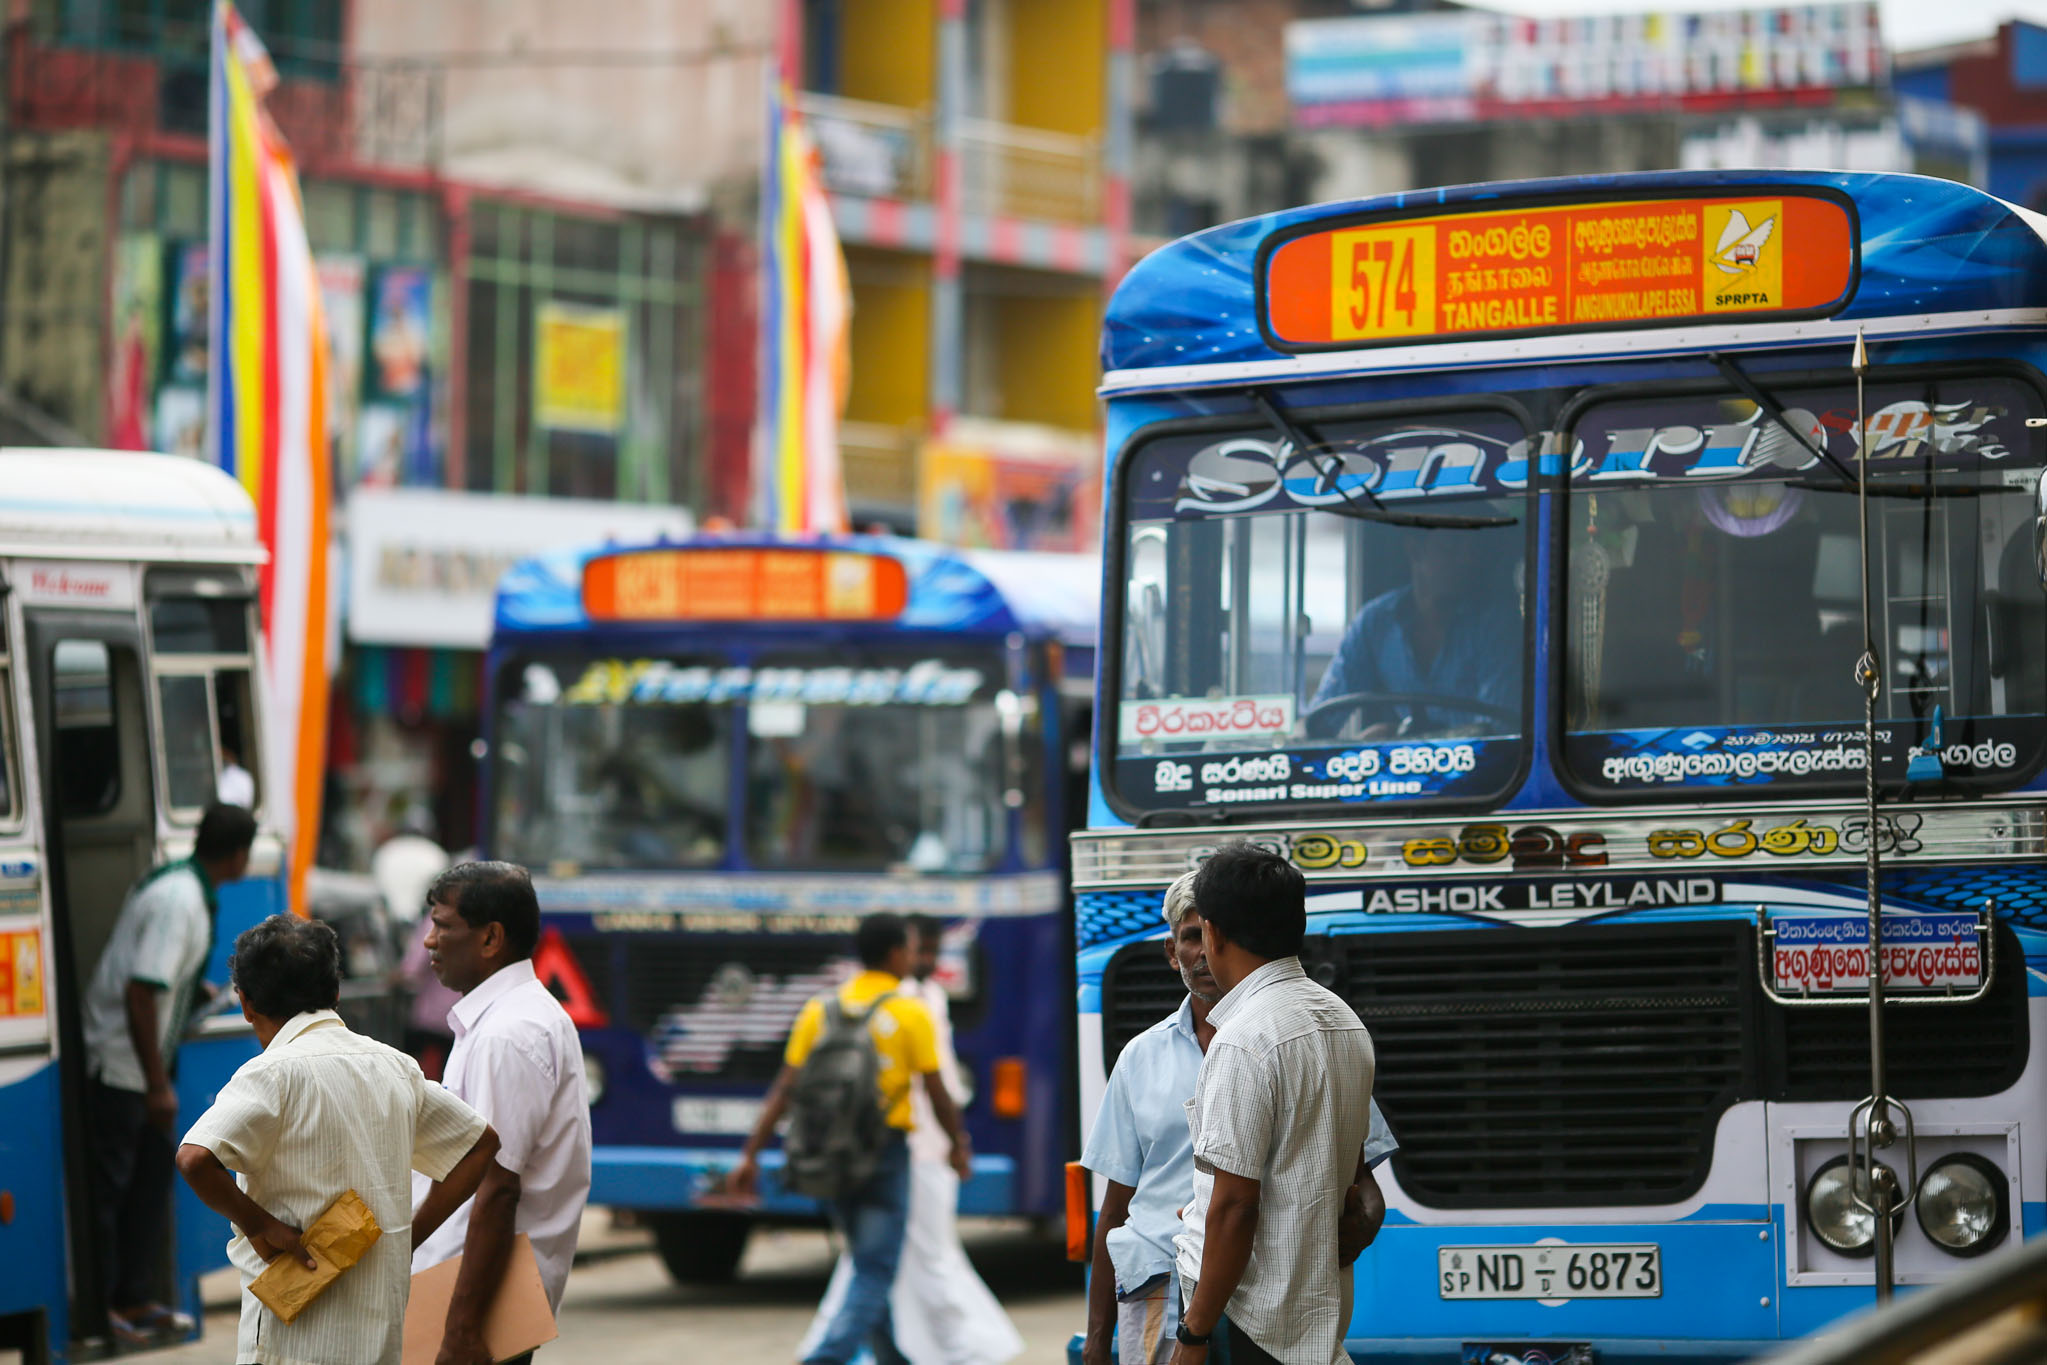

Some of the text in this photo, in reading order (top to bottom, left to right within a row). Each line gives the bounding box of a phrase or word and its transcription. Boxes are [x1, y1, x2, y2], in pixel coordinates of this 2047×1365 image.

[1350, 237, 1416, 331] 574
[1715, 293, 1769, 306] SPRPTA
[1441, 296, 1558, 330] TANGALLE
[1290, 781, 1368, 800] Super
[1368, 780, 1422, 796] Line
[1365, 877, 1718, 914] ASHOK LEYLAND
[1443, 1272, 1471, 1292] SP
[1477, 1254, 1524, 1292] ND
[1567, 1253, 1656, 1291] 6873
